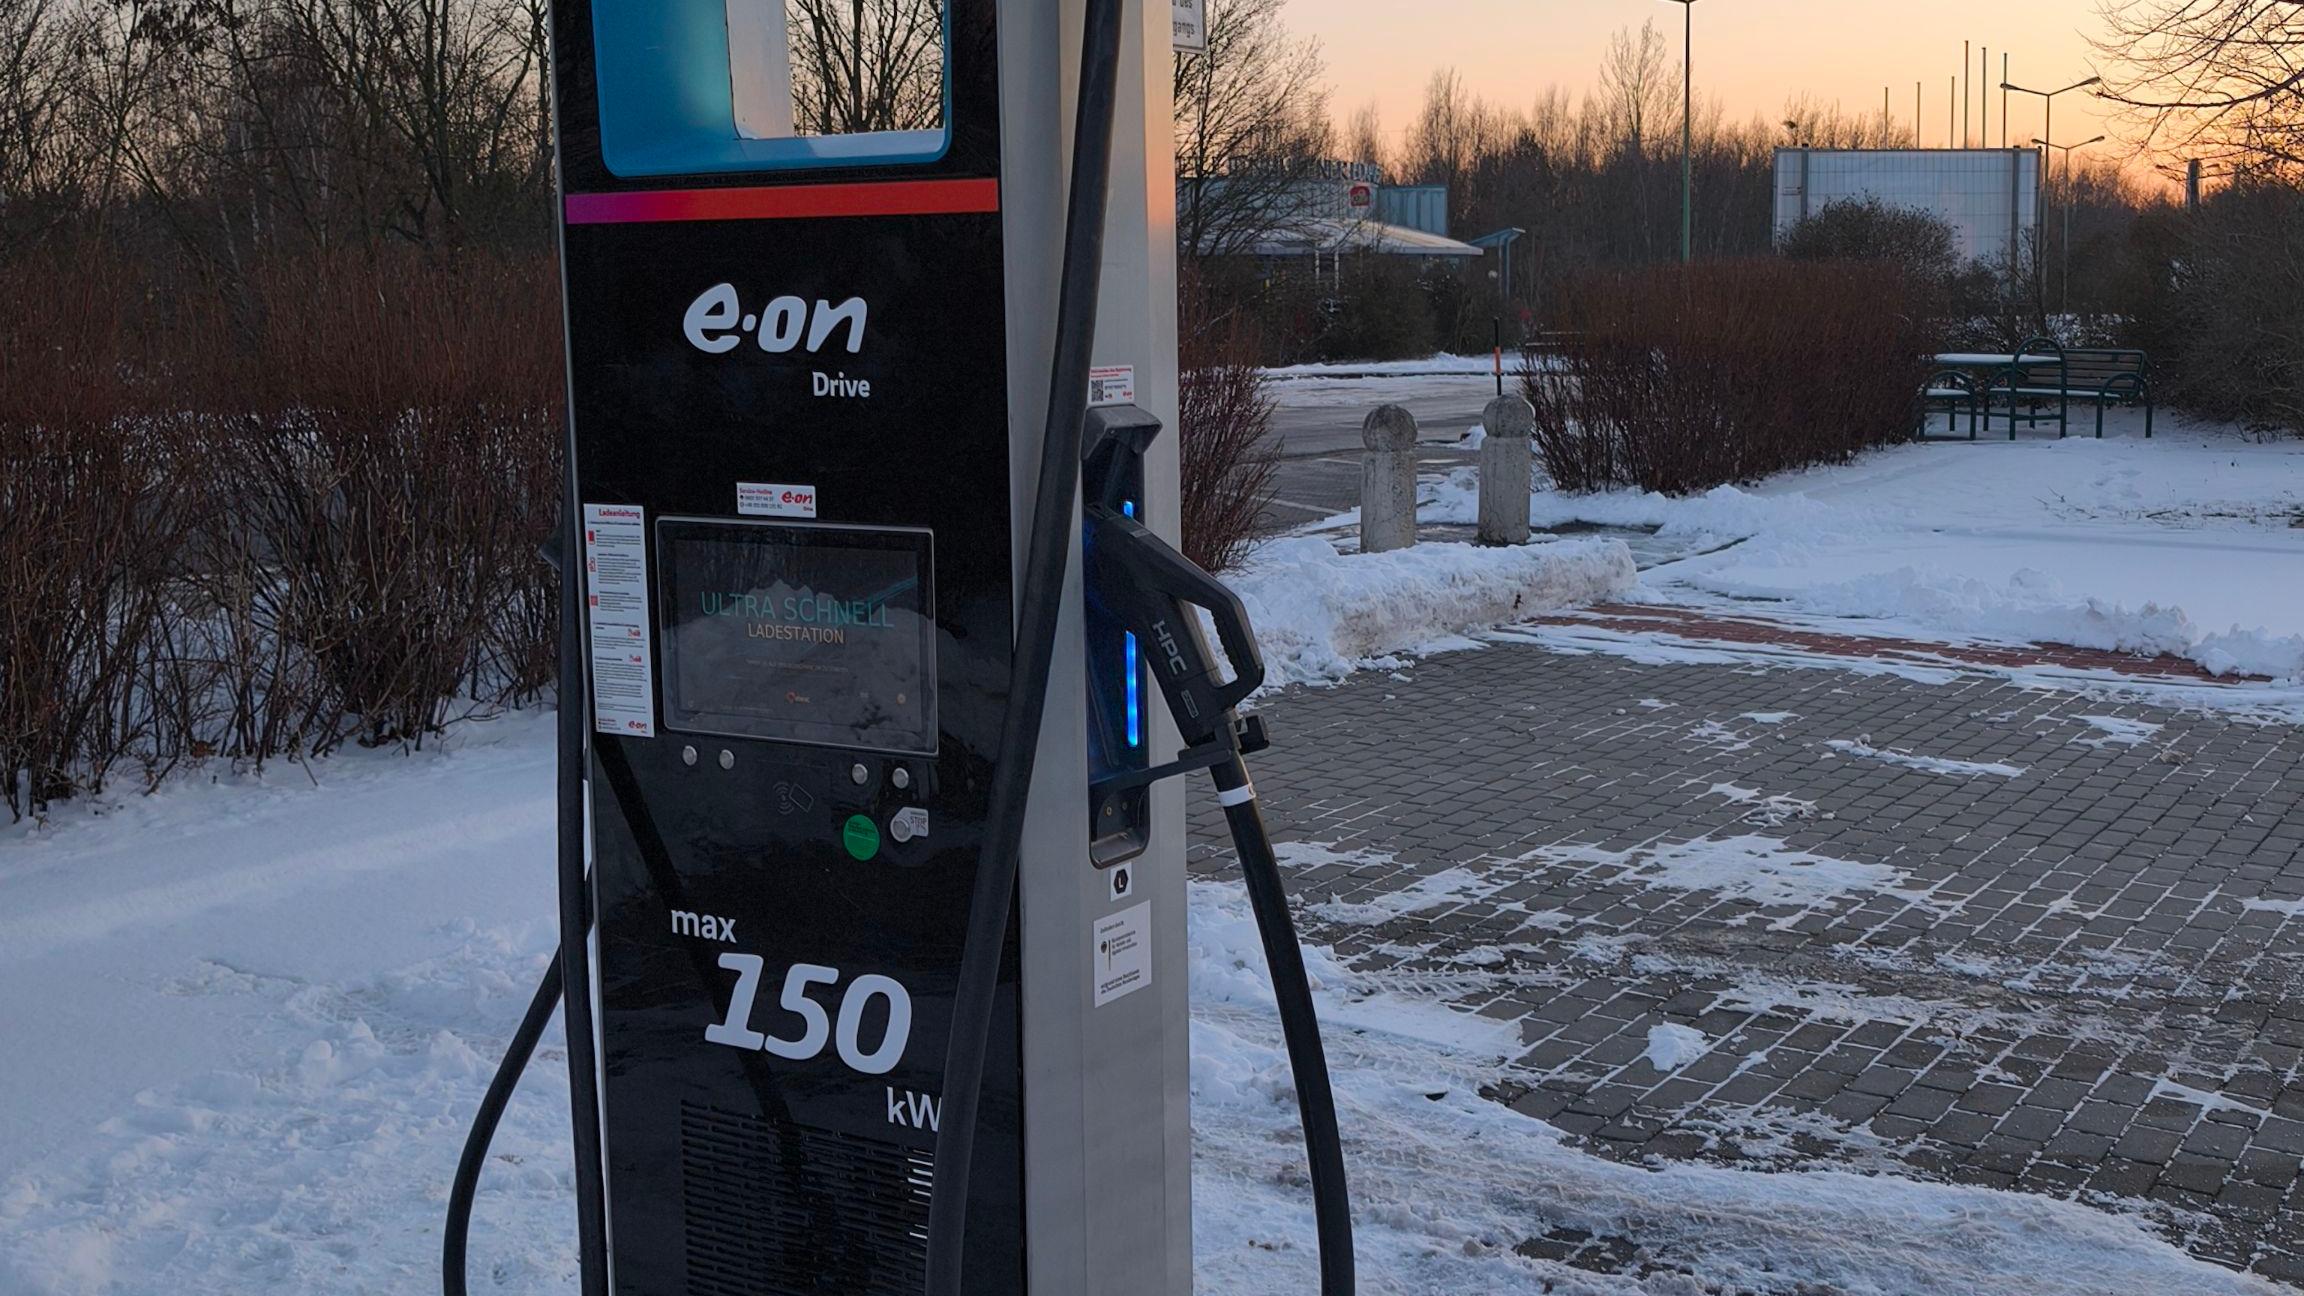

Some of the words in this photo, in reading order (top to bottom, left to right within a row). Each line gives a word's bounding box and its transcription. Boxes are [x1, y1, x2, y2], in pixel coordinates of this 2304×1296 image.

[812, 371, 871, 398] Drive
[701, 591, 776, 620] ULTRA
[784, 597, 895, 628] SCHNELL
[747, 623, 845, 645] LADESTATION
[1152, 619, 1188, 676] HPC
[1118, 877, 1124, 889] L
[670, 909, 738, 943] max
[704, 952, 913, 1075] 150
[886, 1086, 942, 1133] kW
